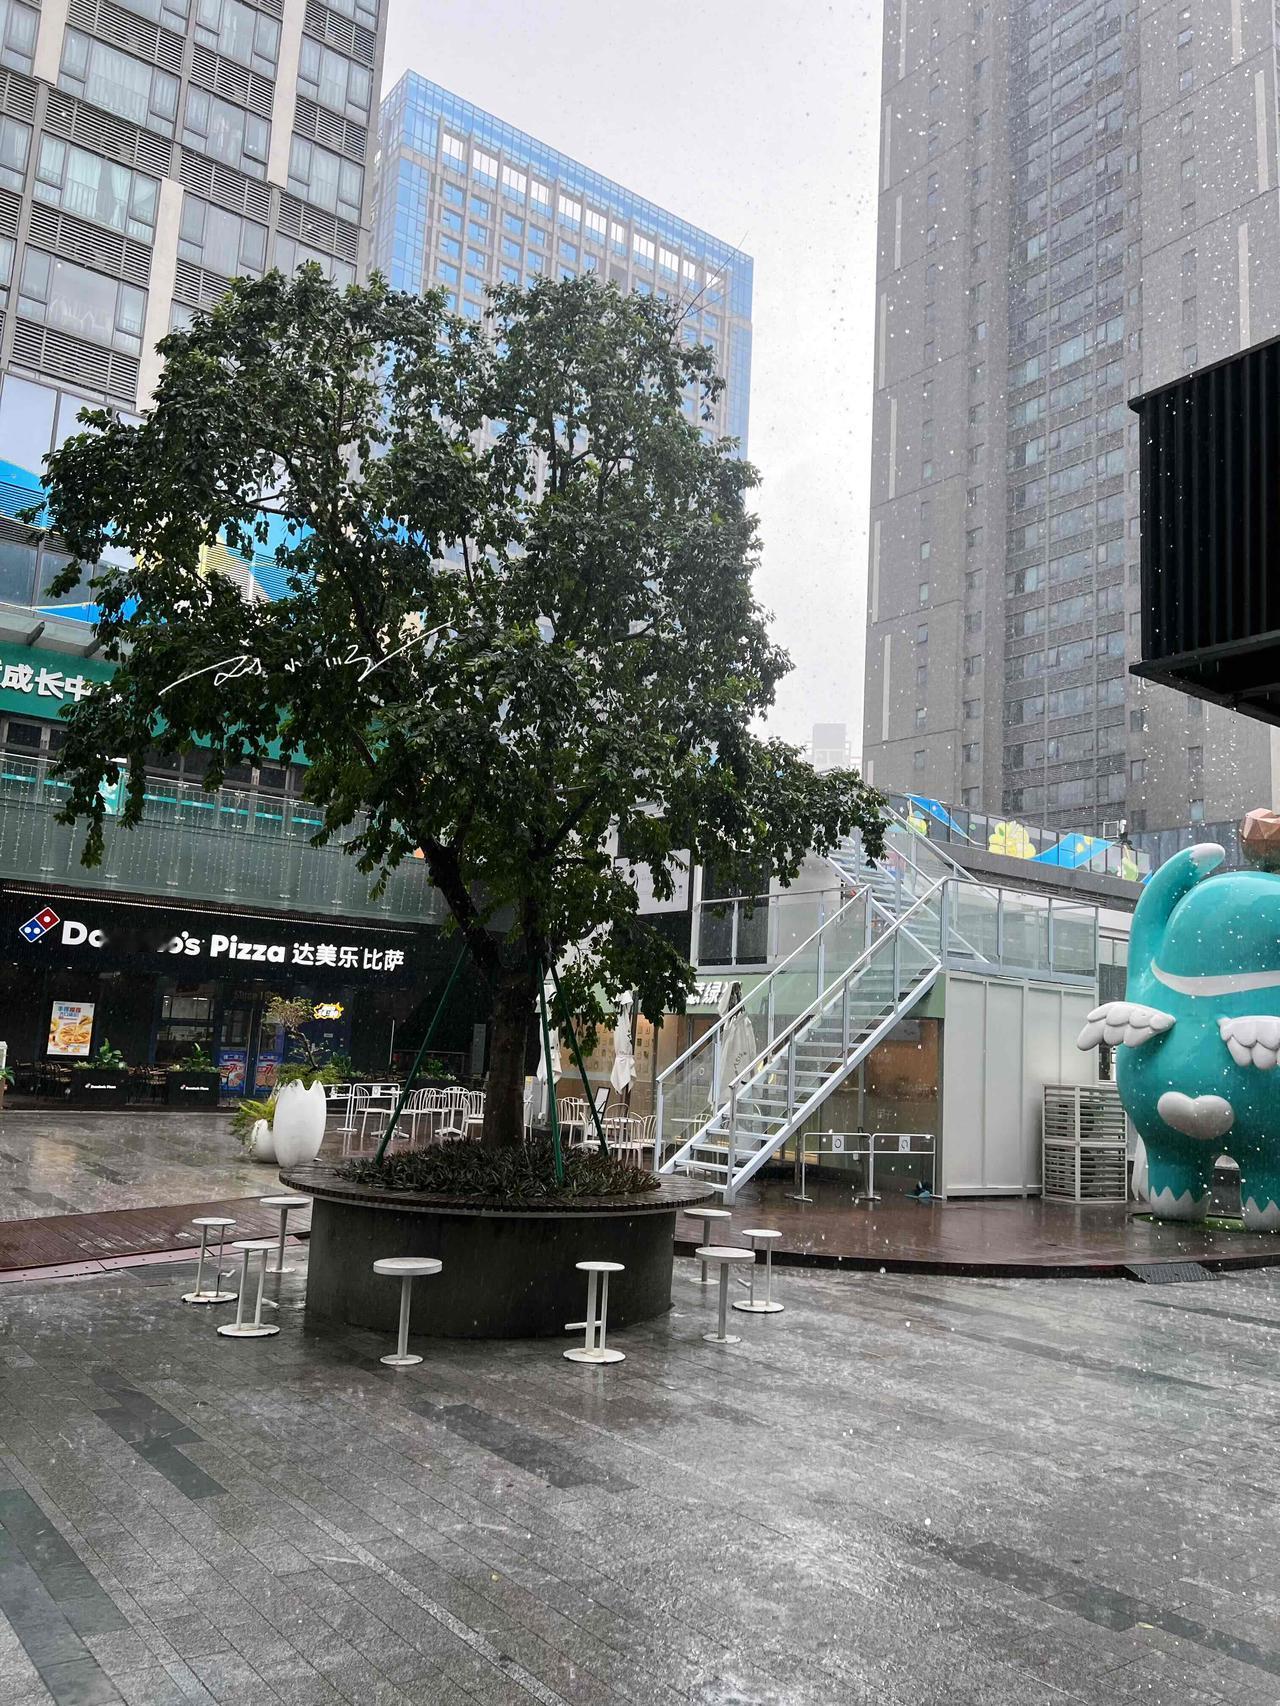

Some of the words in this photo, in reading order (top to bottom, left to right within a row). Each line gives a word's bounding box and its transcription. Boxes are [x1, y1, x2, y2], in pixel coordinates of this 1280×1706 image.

[61, 920, 200, 956] Doo's
[209, 934, 286, 963] Pizza
[291, 942, 404, 972] 达美乐比萨
